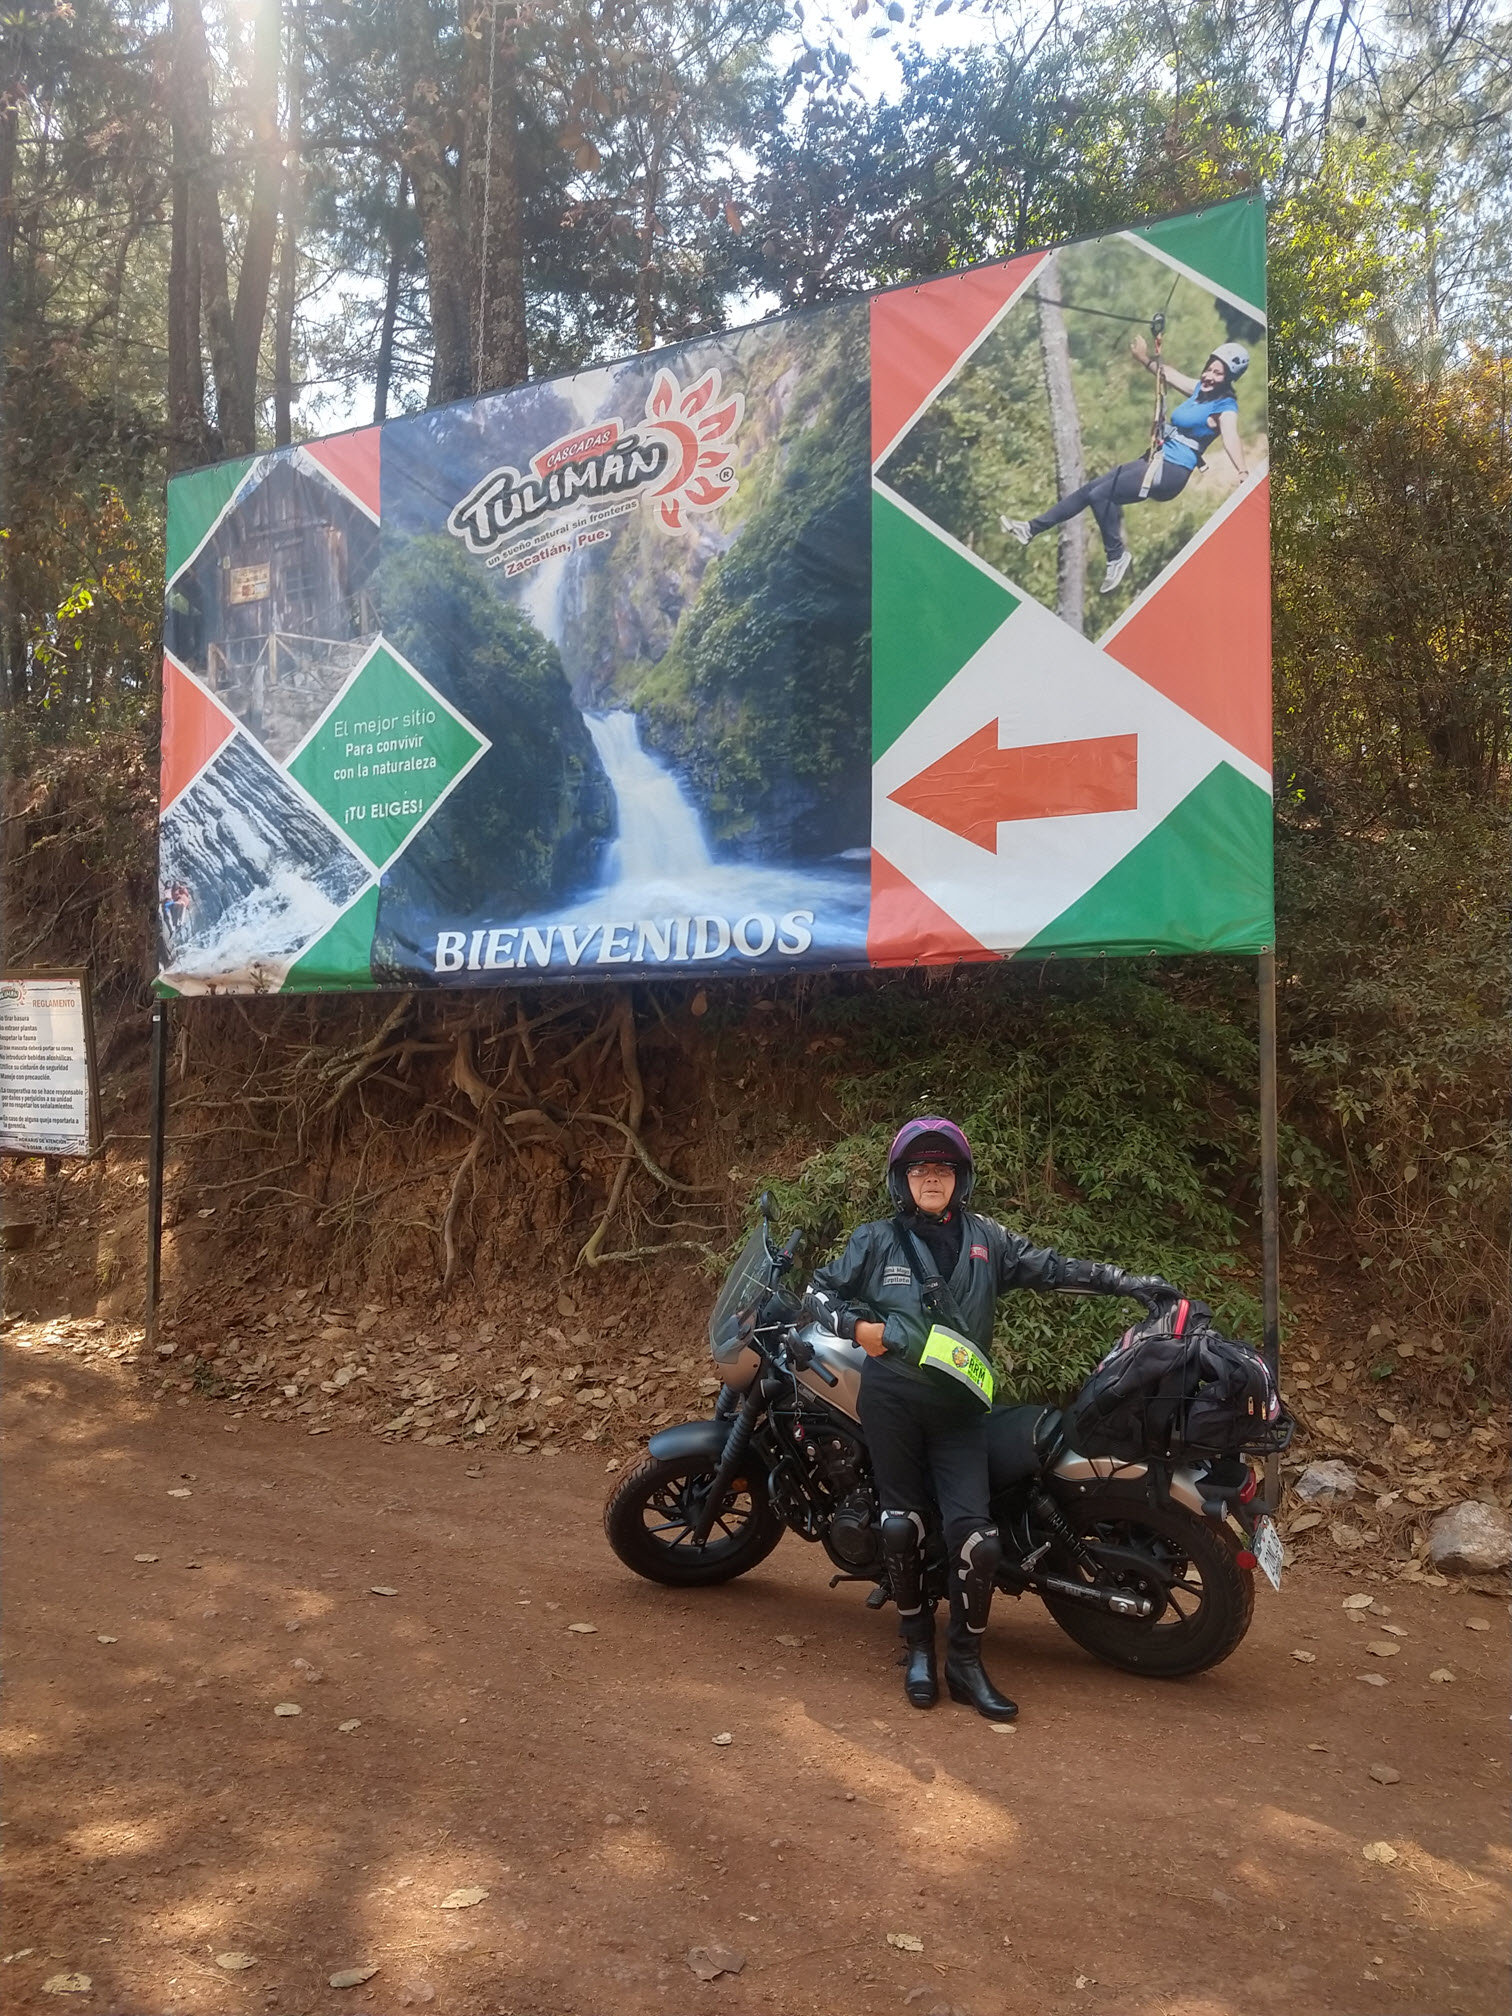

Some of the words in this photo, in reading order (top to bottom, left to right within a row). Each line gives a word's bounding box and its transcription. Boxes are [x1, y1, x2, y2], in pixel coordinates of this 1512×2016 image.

[546, 431, 611, 469] CASCADAS
[461, 436, 660, 538] TULIMÁN
[488, 555, 501, 567] un
[503, 540, 531, 559] sueño
[534, 524, 570, 546] natural
[572, 518, 588, 530] sin
[589, 500, 638, 523] fronteras
[506, 544, 572, 576] Zacatlán,
[577, 529, 610, 547] Pue.
[334, 721, 349, 738] El
[354, 715, 399, 736] mejor
[402, 707, 436, 728] sitio
[345, 743, 373, 758] Para
[376, 733, 424, 754] convivir
[333, 767, 354, 781] con
[357, 763, 369, 779] la
[372, 756, 437, 776] naturaleza
[344, 805, 366, 825] ¡TU
[434, 910, 815, 973] BIENVENIDOS
[32, 1000, 75, 1008] REGLAMENTO
[7, 1088, 31, 1096] cooperativa
[24, 1116, 39, 1124] alguna
[39, 1117, 52, 1125] queja
